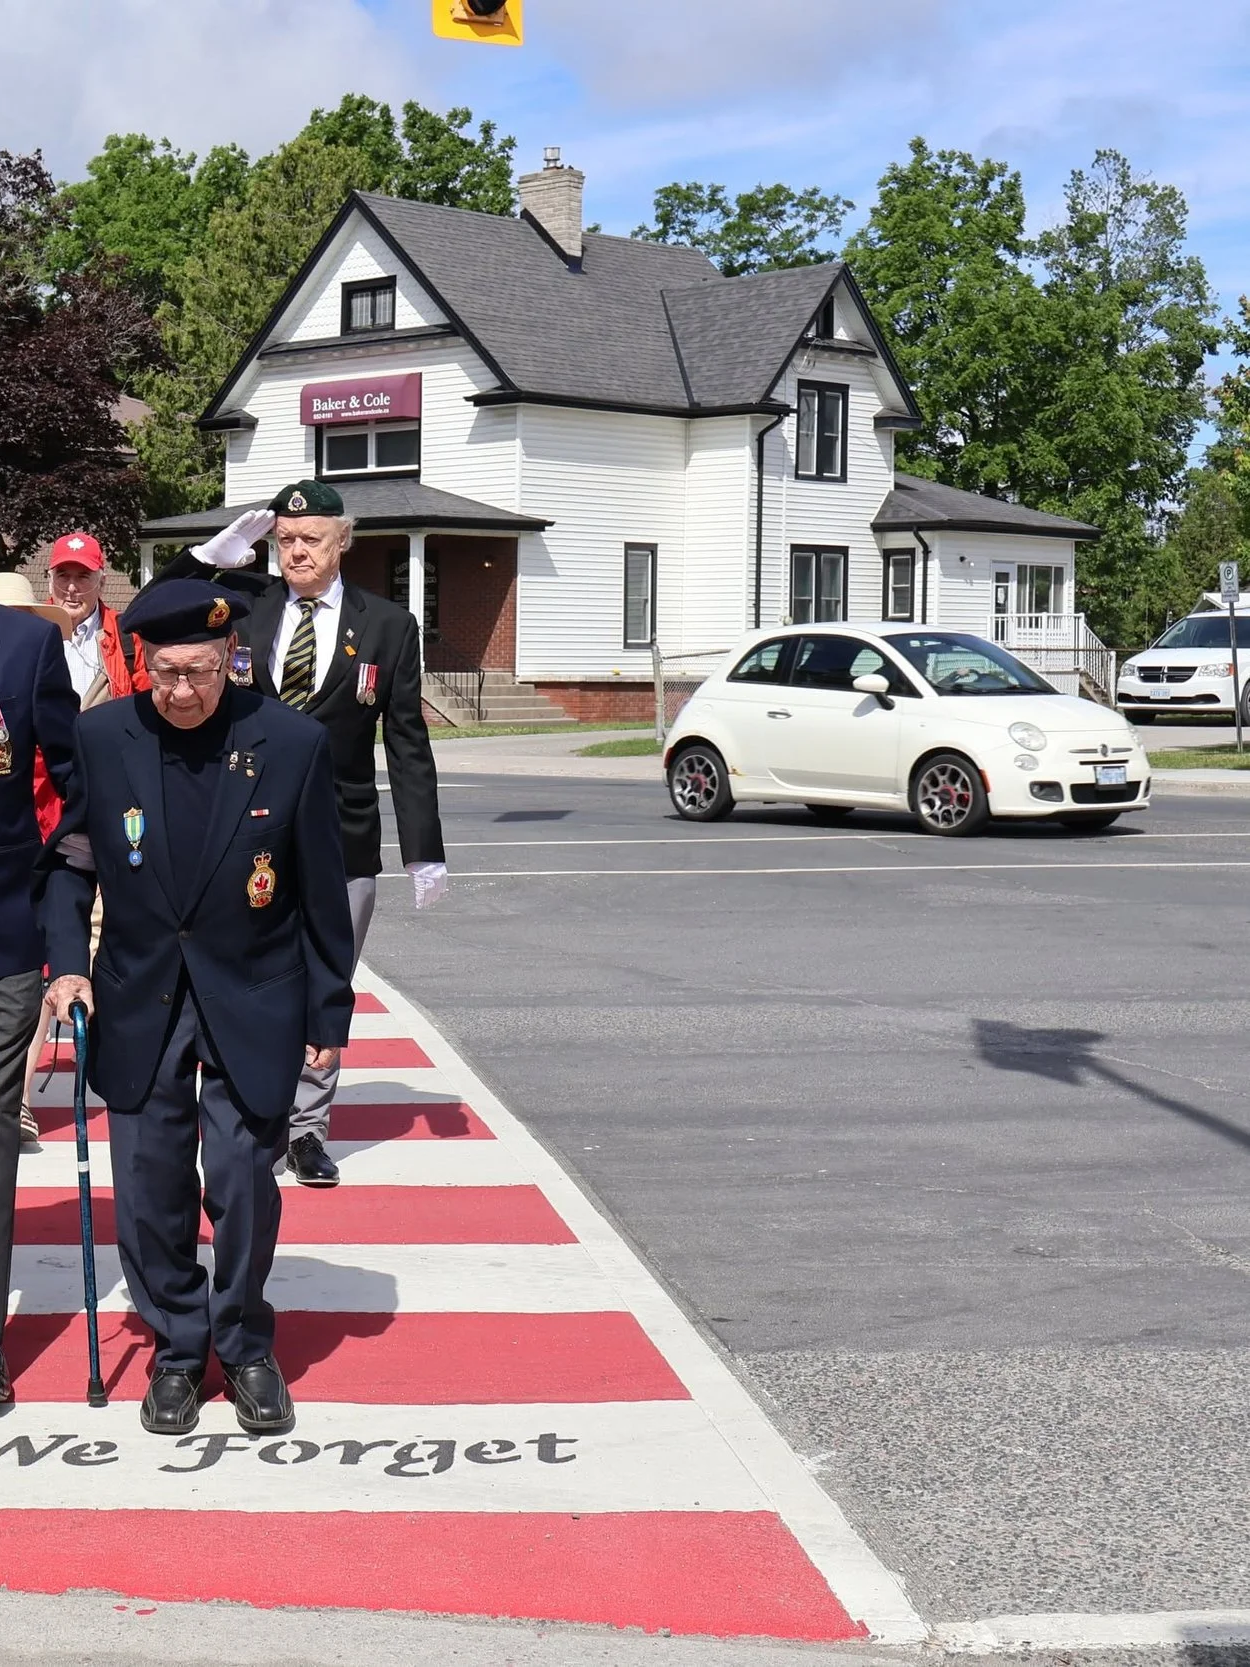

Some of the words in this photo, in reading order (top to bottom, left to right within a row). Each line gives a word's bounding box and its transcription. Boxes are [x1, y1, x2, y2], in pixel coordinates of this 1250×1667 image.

[312, 397, 346, 411] Baker
[350, 395, 360, 408] &
[363, 392, 391, 407] Cole
[157, 1432, 579, 1478] Forget
